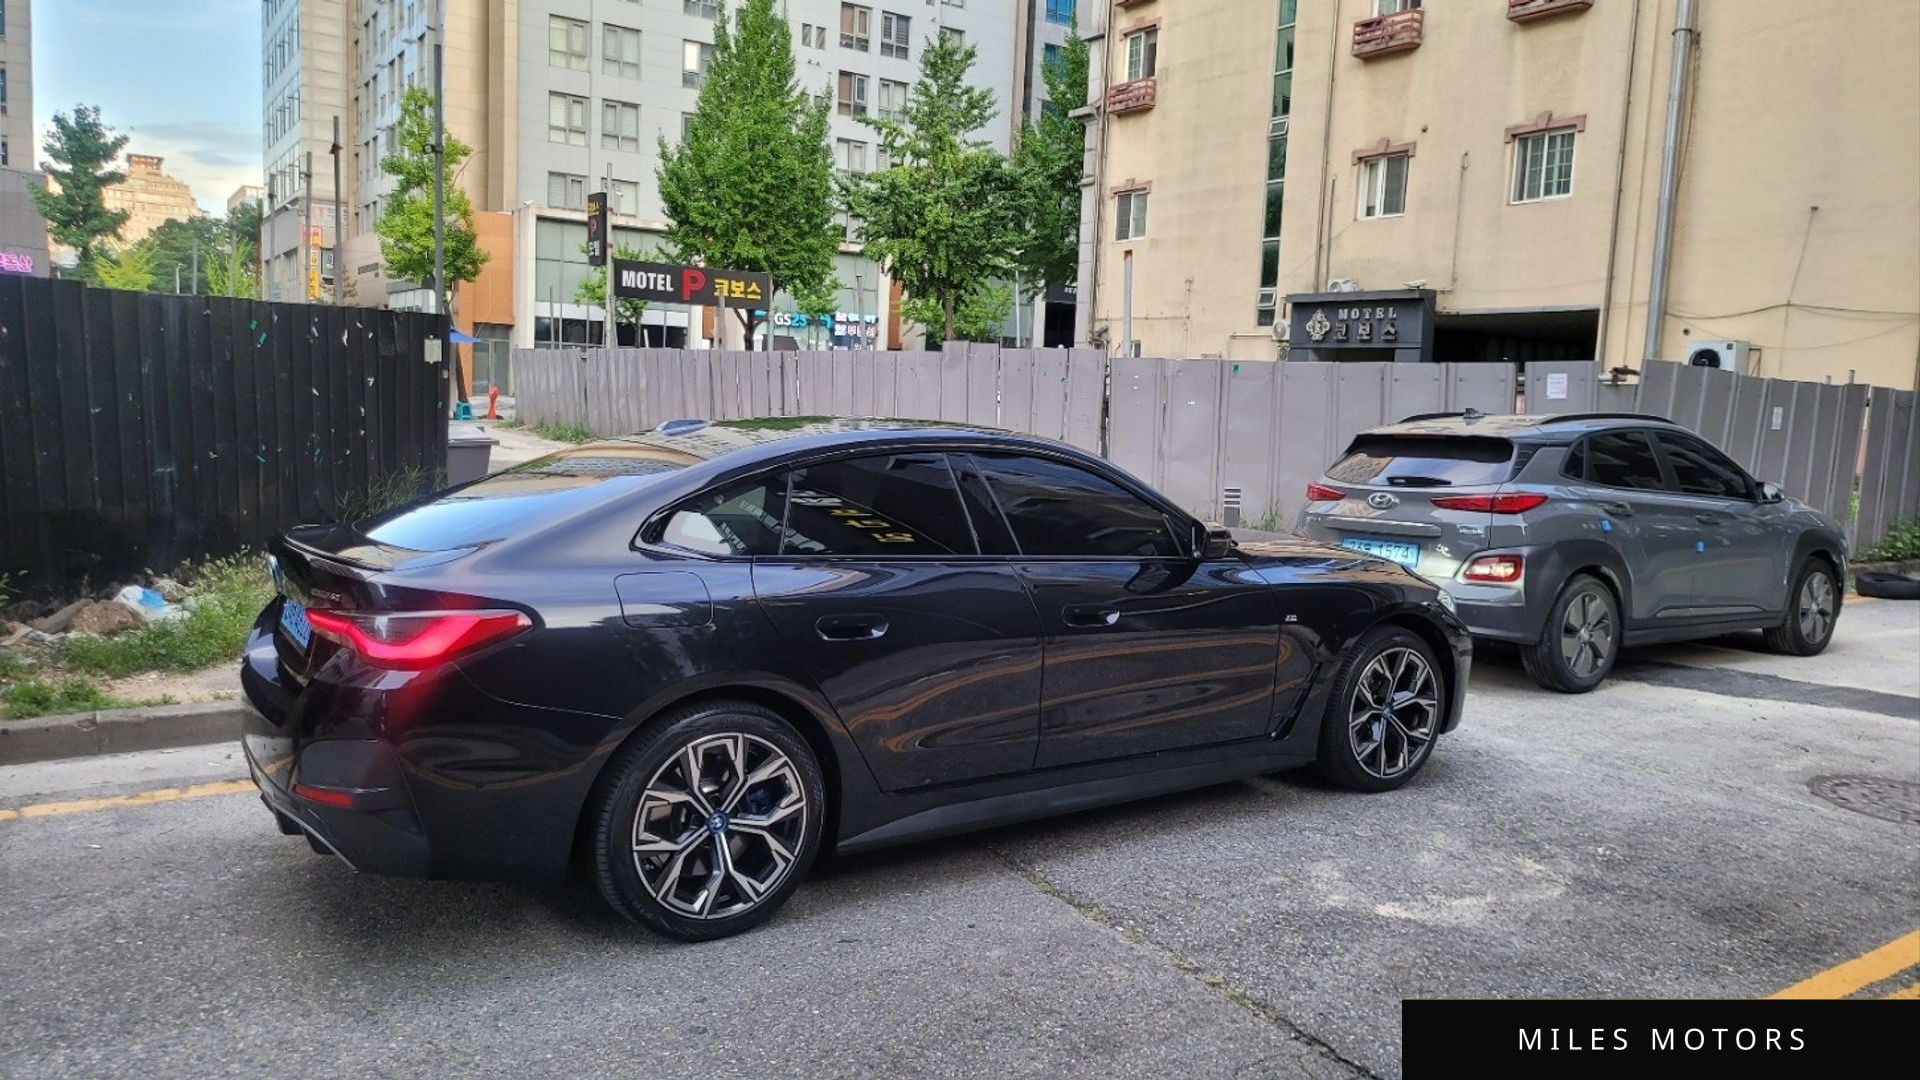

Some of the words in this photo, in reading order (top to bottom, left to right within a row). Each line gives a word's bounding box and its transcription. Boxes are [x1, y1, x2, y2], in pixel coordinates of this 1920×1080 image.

[622, 269, 674, 292] MOTEL
[682, 268, 706, 300] P
[714, 278, 762, 300] 코보스
[774, 312, 808, 327] GS25
[1338, 307, 1397, 320] MOTEL
